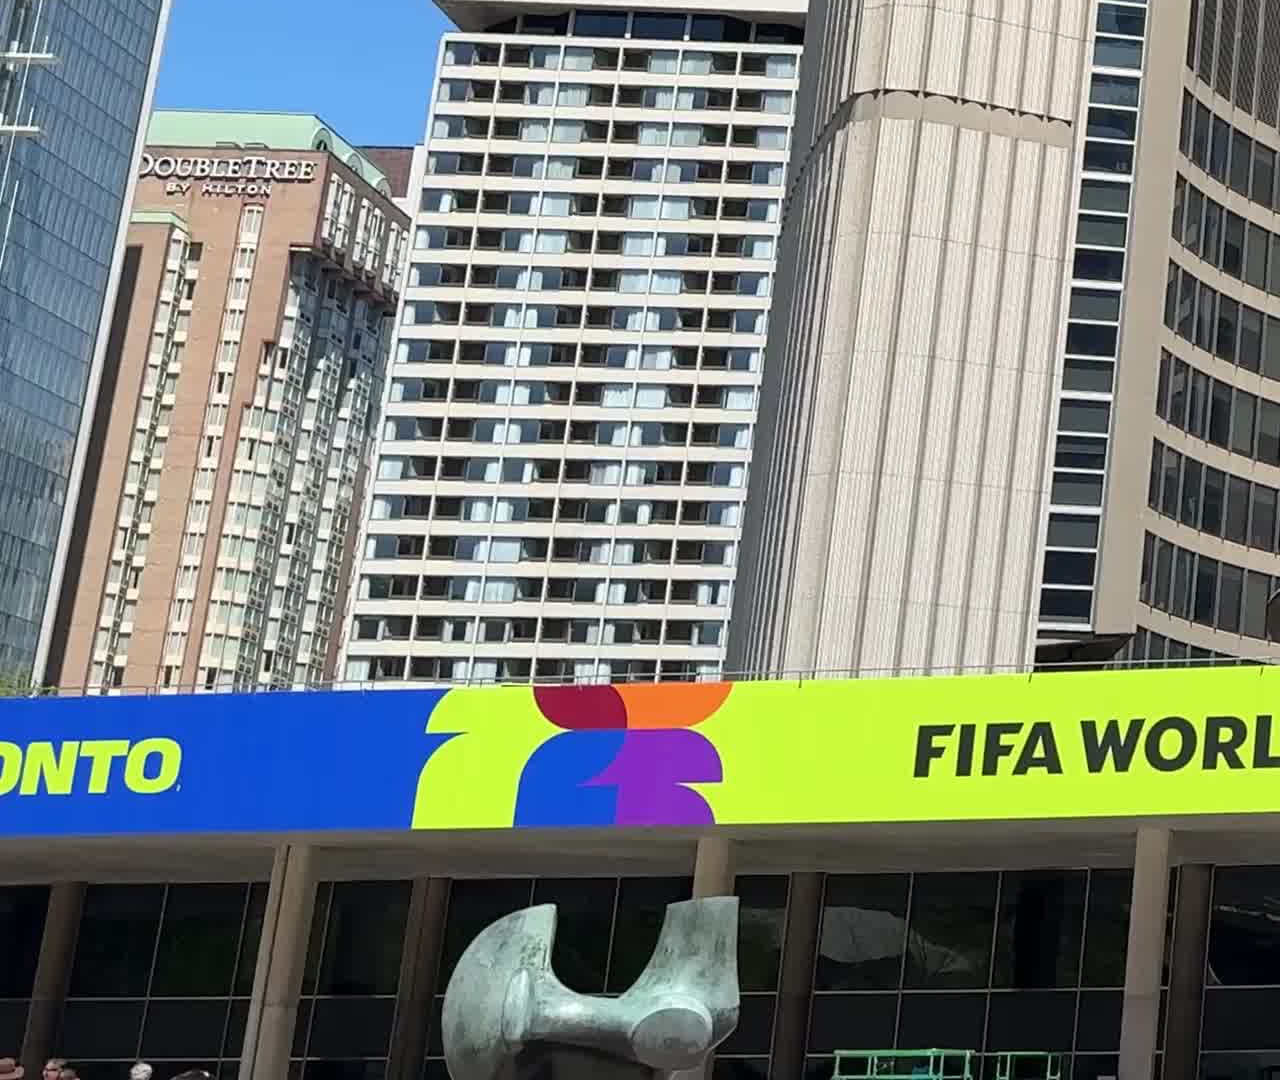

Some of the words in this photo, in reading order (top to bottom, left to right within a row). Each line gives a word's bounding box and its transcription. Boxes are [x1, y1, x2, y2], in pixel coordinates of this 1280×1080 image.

[166, 182, 190, 193] BY
[202, 183, 272, 195] HILTON
[913, 720, 1064, 778] FIFA
